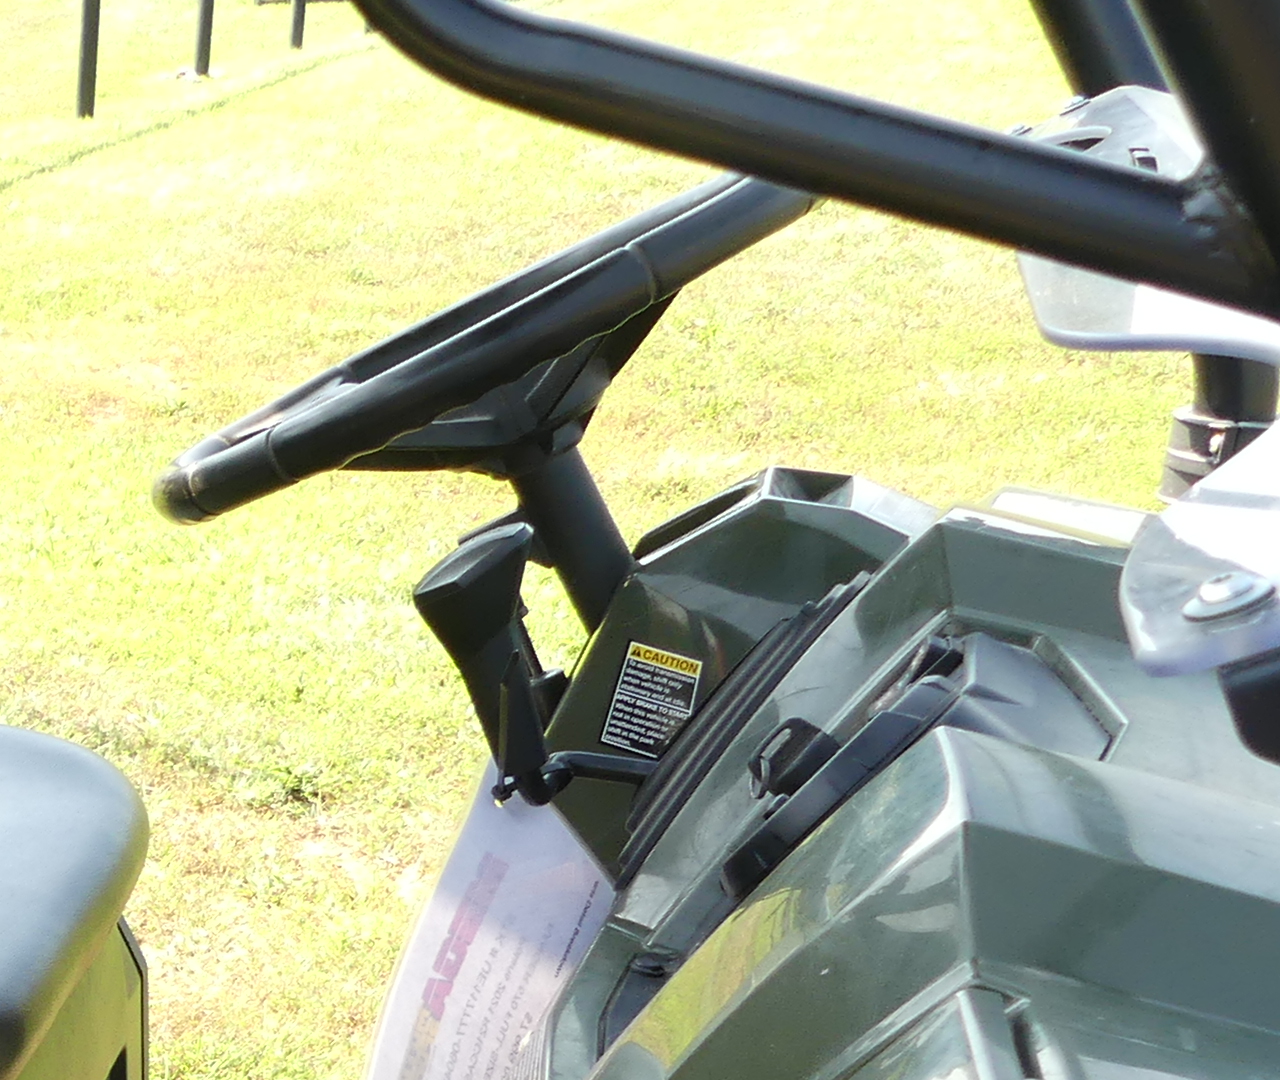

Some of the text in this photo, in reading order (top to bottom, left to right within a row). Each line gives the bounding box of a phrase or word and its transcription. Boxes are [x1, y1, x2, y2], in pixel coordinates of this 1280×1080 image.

[643, 650, 698, 673] CAUTION
[622, 675, 640, 684] when
[640, 680, 663, 692] vehicle
[624, 666, 683, 691] damage, shift only
[636, 662, 654, 672] avoid
[654, 667, 695, 684] transmission
[615, 693, 636, 705] APPLY
[635, 698, 658, 711] BRAKE
[657, 705, 668, 715] TO
[650, 691, 664, 700] and
[614, 702, 633, 713] When
[645, 712, 669, 724] vehicle
[629, 715, 661, 730] operation
[638, 735, 655, 747] park
